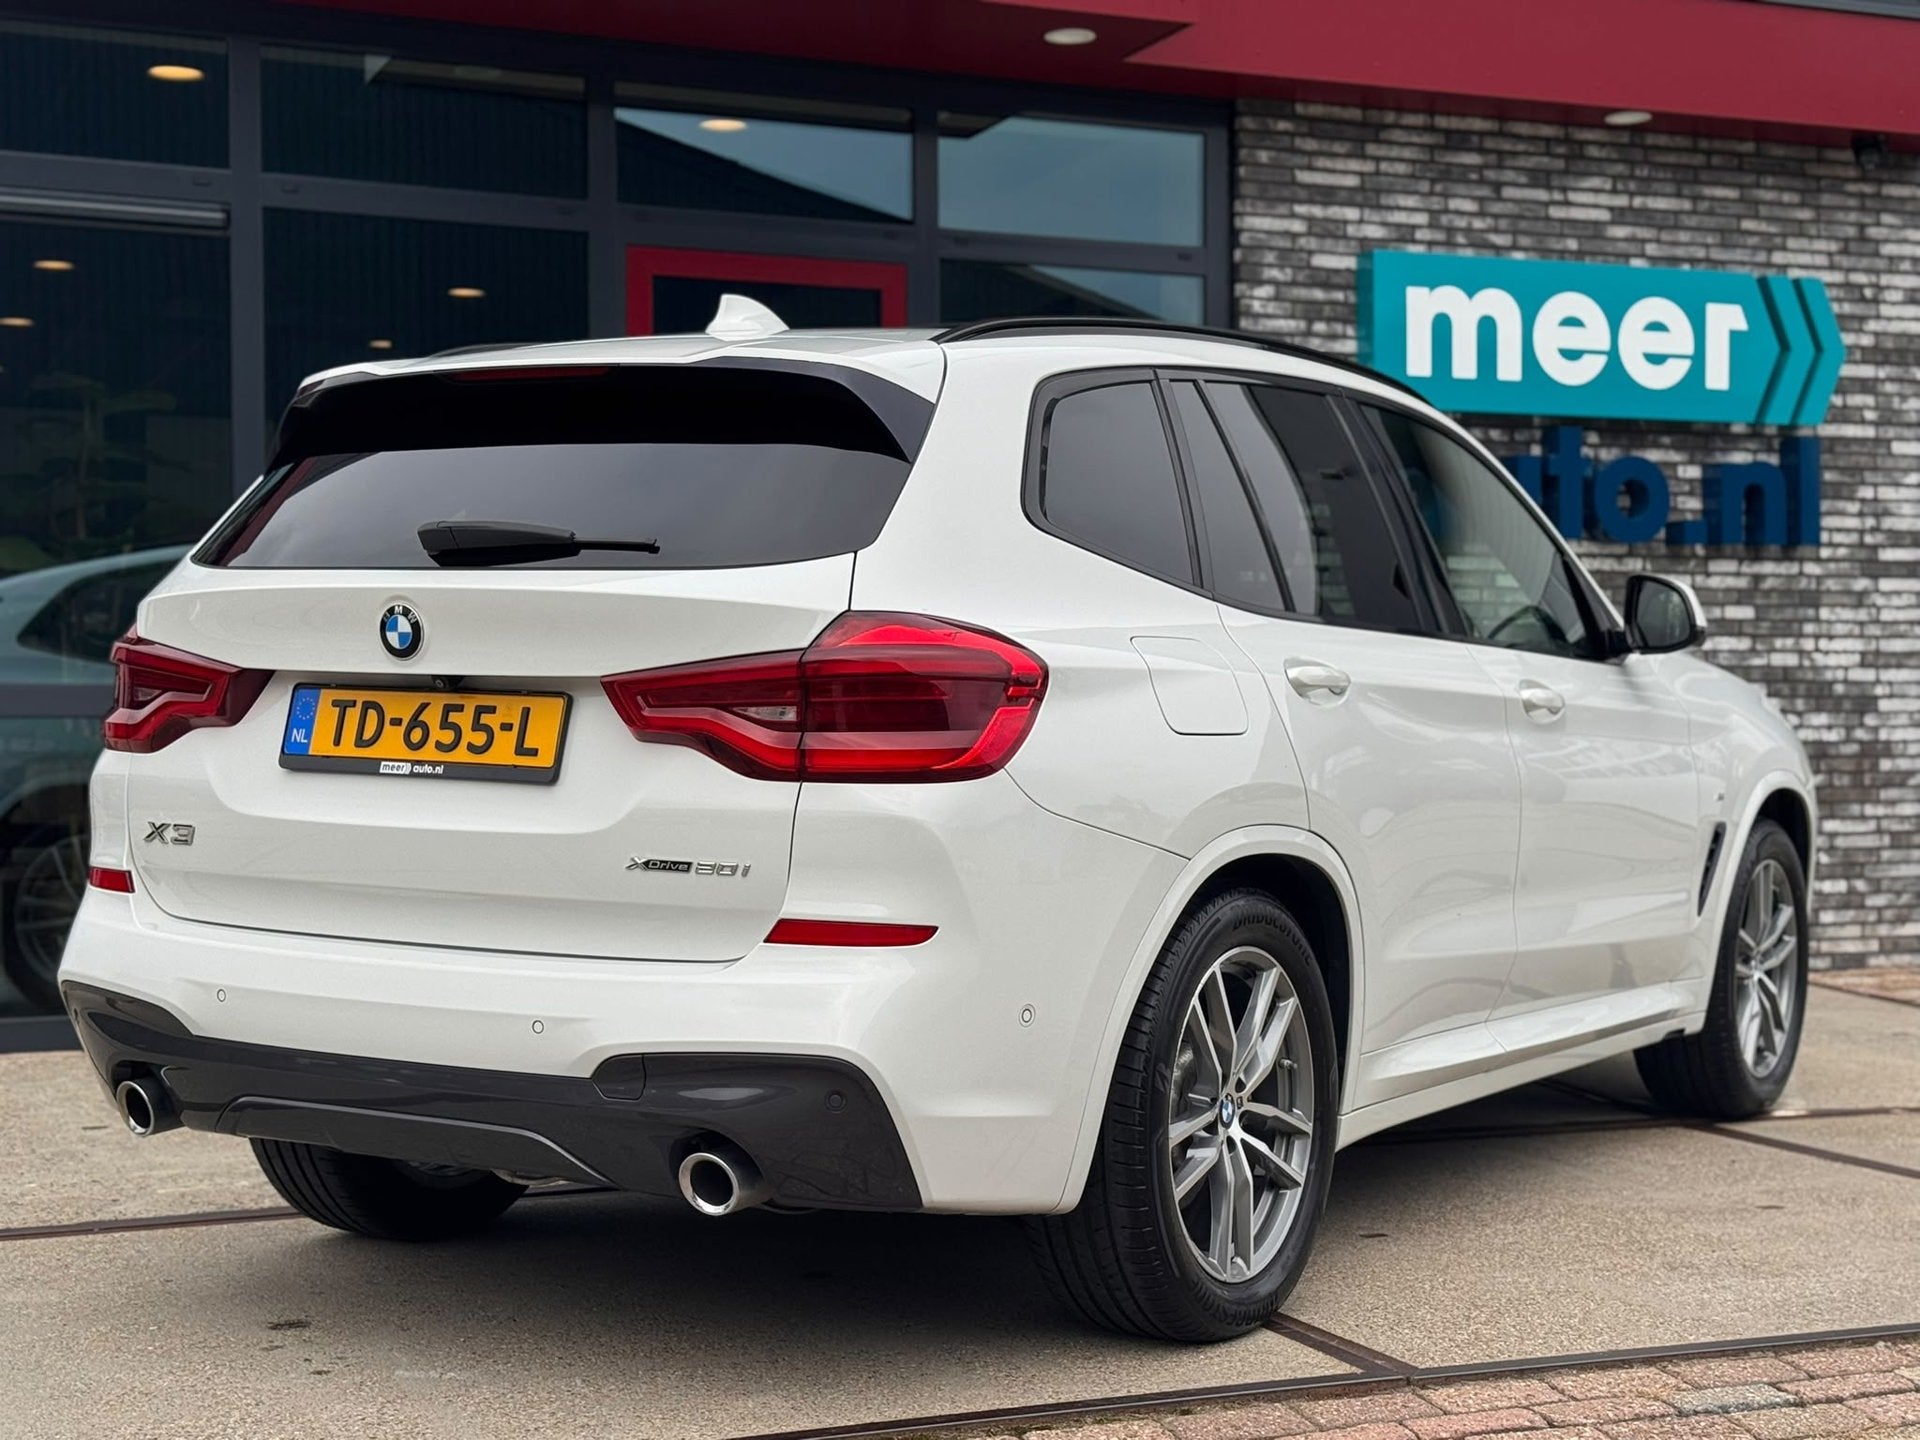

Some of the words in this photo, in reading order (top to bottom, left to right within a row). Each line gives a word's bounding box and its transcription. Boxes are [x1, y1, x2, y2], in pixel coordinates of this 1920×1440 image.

[1406, 284, 1749, 391] meer
[382, 605, 418, 624] BMW
[291, 728, 308, 743] NL
[331, 698, 539, 757] TD-655-L
[382, 763, 405, 771] meer
[413, 764, 443, 774] auto.nl
[143, 821, 196, 846] X3
